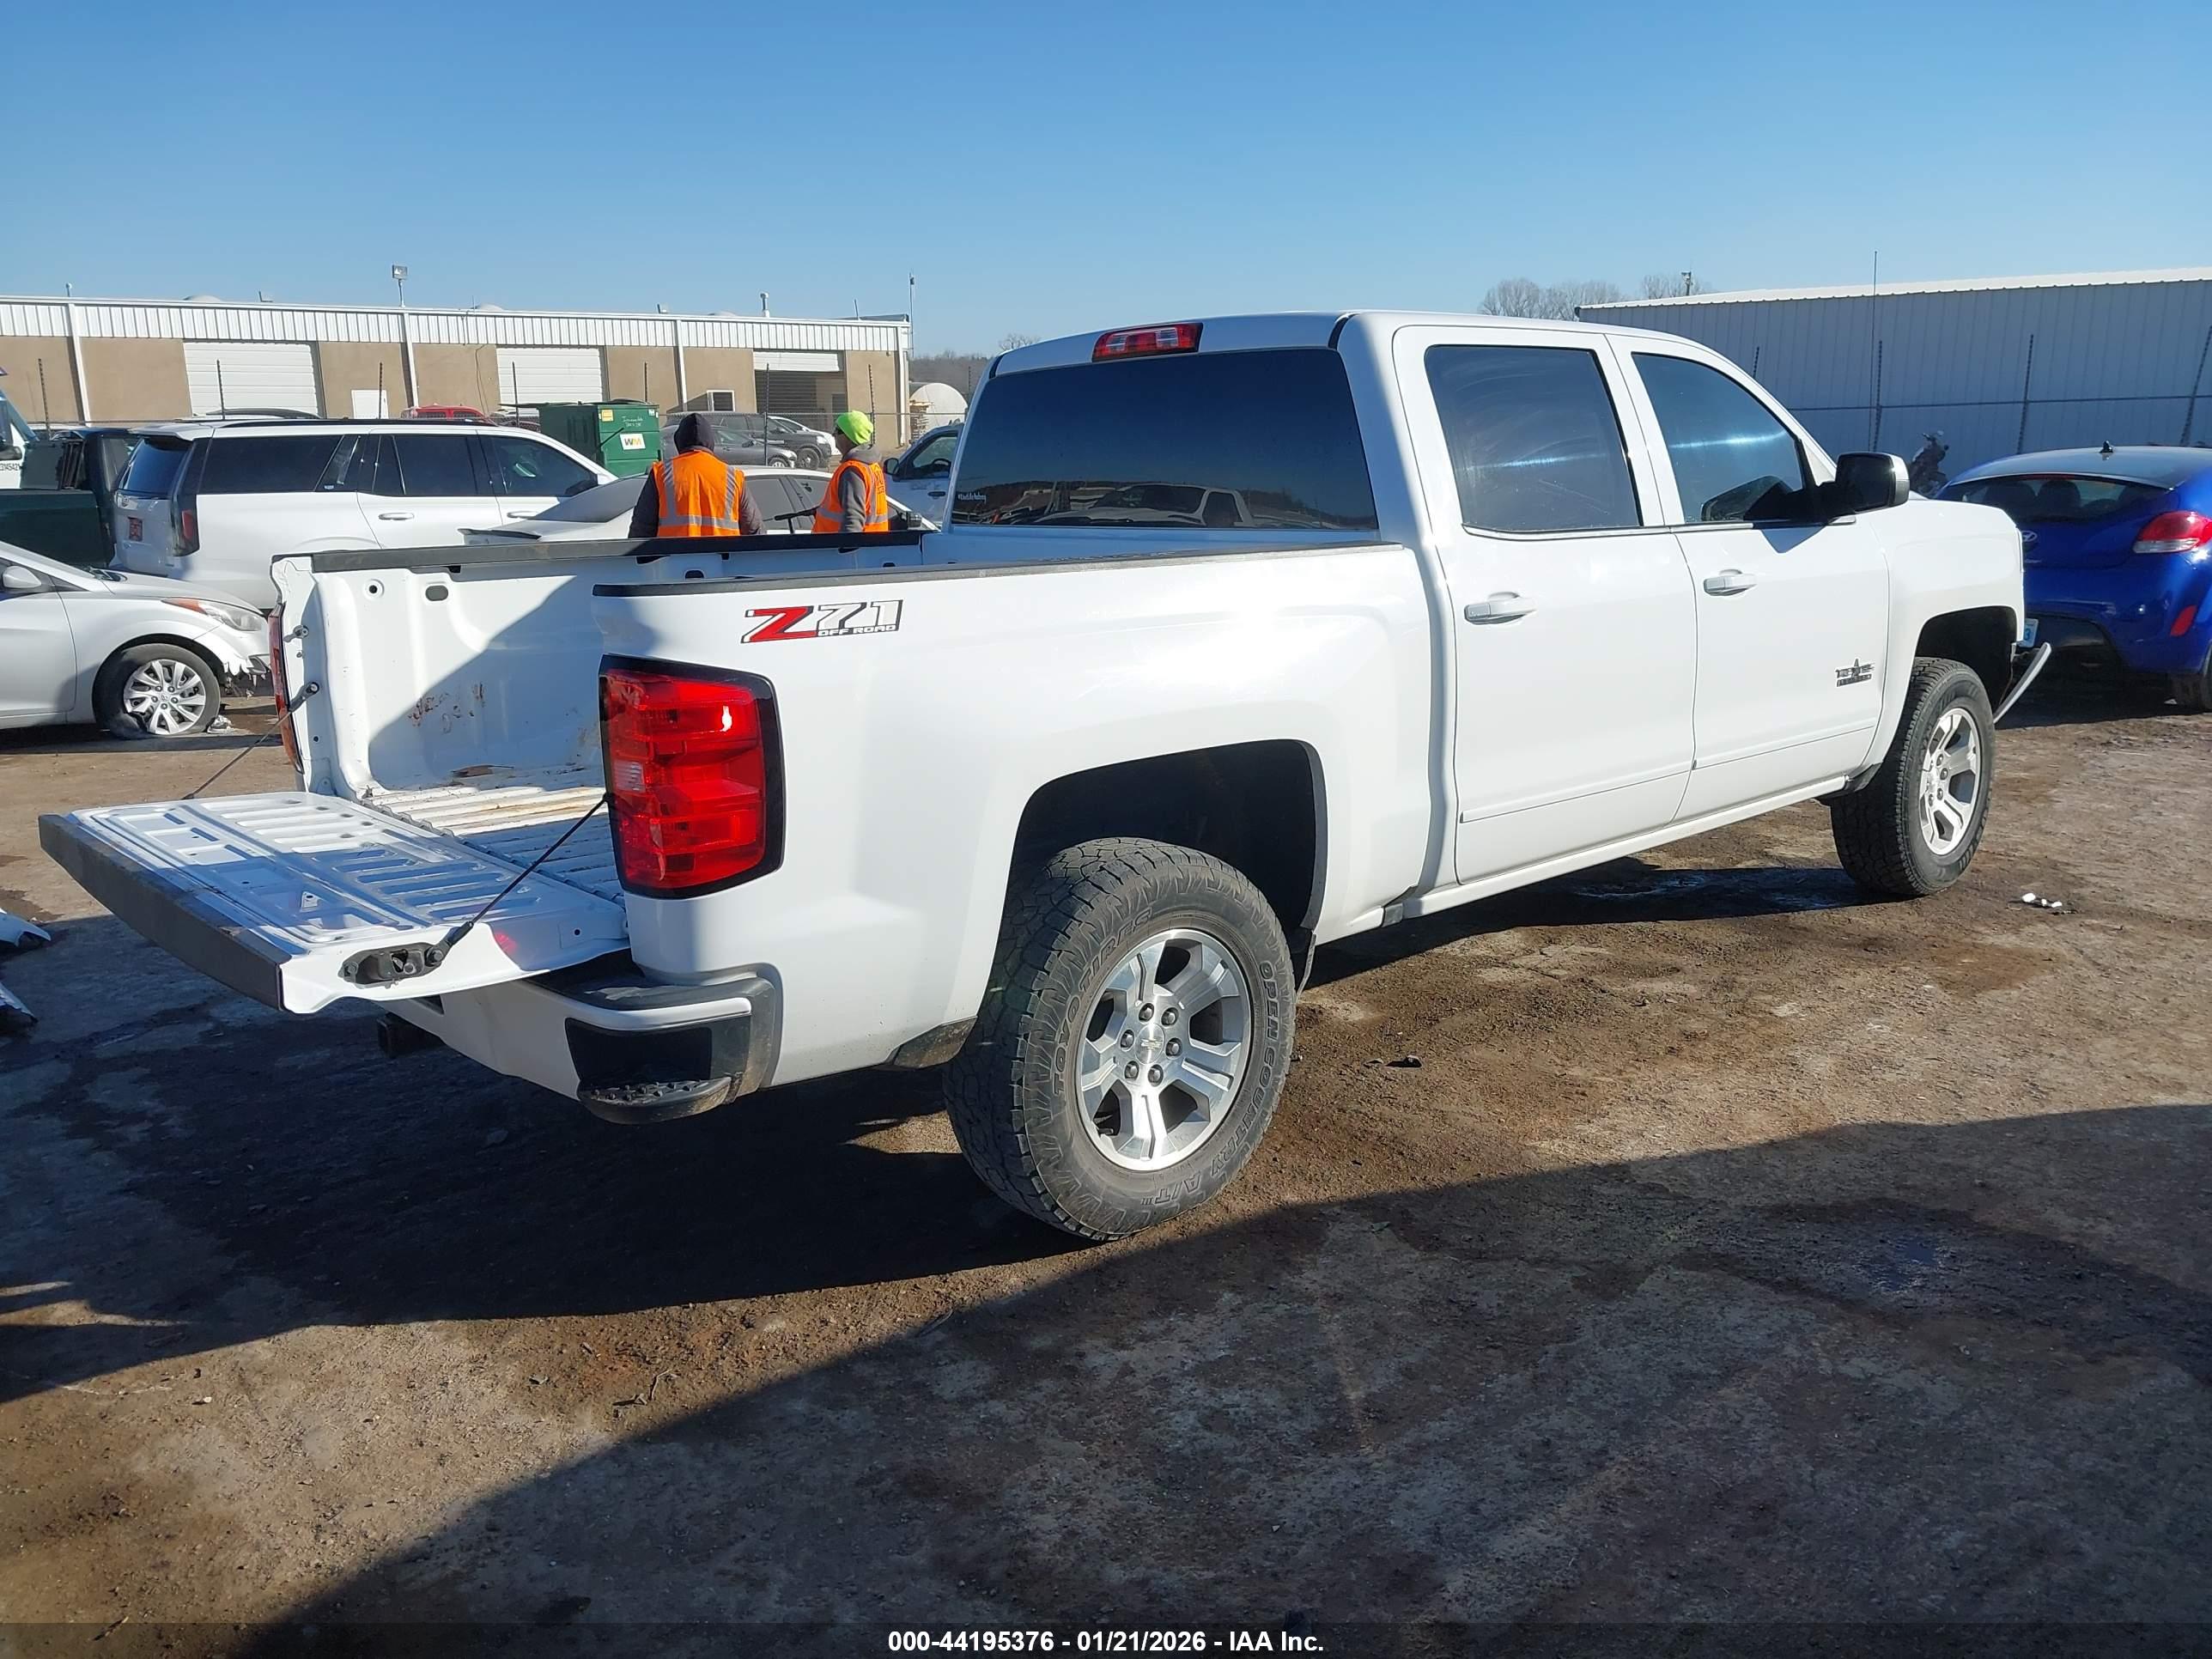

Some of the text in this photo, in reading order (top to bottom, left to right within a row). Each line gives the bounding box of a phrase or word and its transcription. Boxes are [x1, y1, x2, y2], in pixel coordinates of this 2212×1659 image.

[740, 599, 903, 644] Z71
[817, 624, 896, 638] OFF ROAD
[1052, 908, 1152, 1096] TOYO TIRES
[1259, 960, 1280, 1041] OPEN
[1211, 1046, 1276, 1178] COUNTRY
